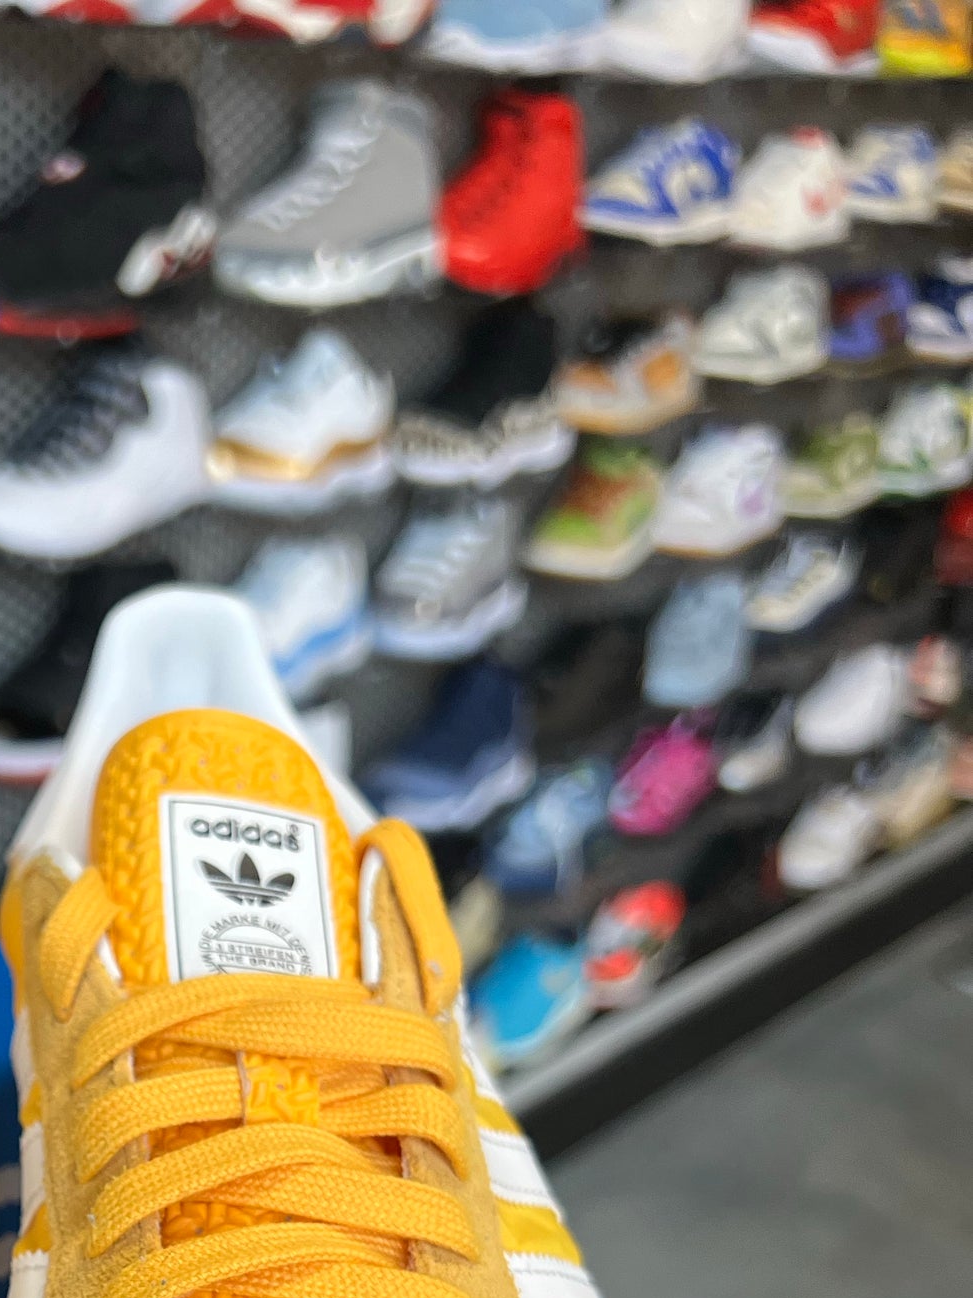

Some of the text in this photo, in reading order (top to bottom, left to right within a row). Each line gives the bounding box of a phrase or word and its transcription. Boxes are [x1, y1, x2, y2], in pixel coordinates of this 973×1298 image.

[191, 818, 300, 852] adidas
[210, 914, 261, 932] MARKE
[265, 919, 291, 937] MIT
[228, 944, 295, 961] STREIFEN
